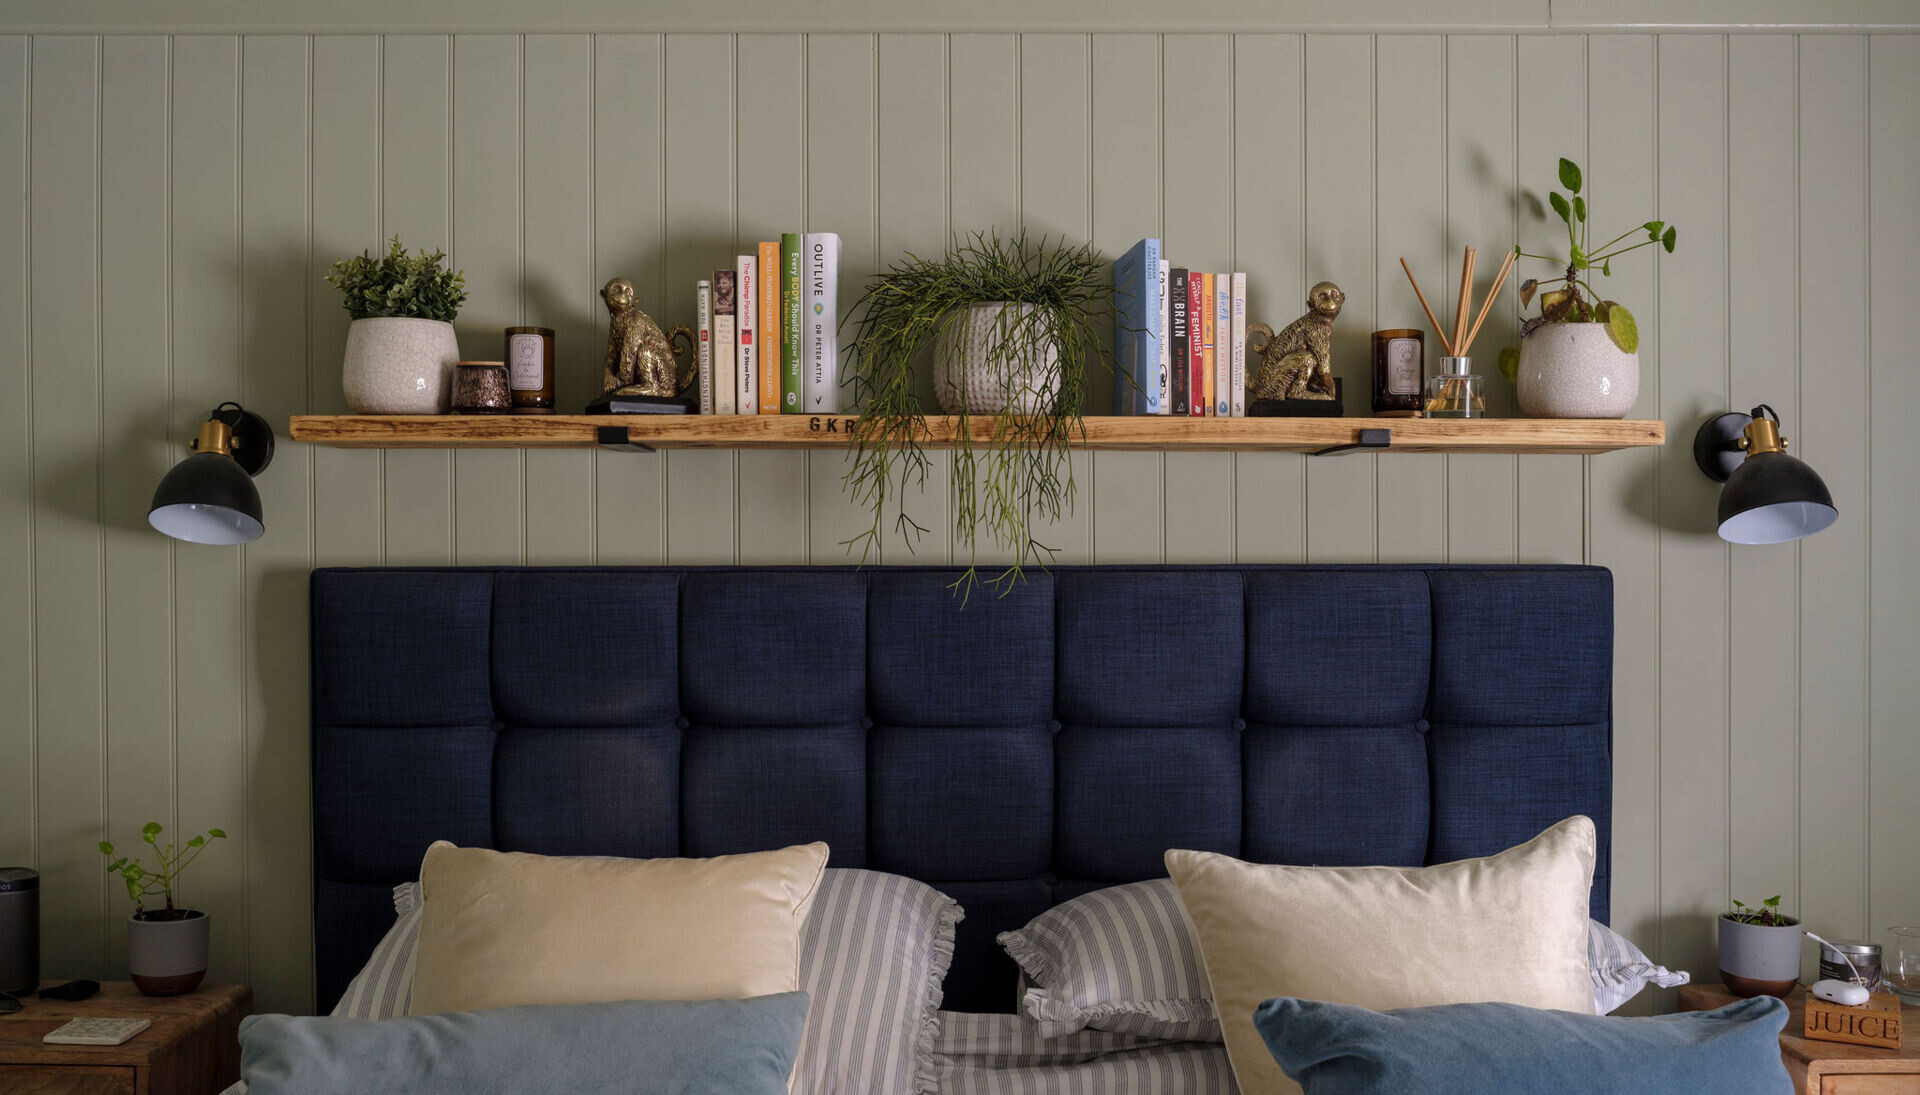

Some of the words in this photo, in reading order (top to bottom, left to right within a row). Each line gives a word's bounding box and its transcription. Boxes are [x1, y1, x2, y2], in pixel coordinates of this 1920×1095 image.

[790, 253, 799, 275] Every
[814, 243, 823, 296] OUTLIVE
[1174, 303, 1185, 338] BRAIN
[1236, 298, 1244, 316] fast
[815, 324, 822, 335] DR
[1191, 312, 1202, 358] FEMINIST
[1809, 1010, 1900, 1040] JUICE
